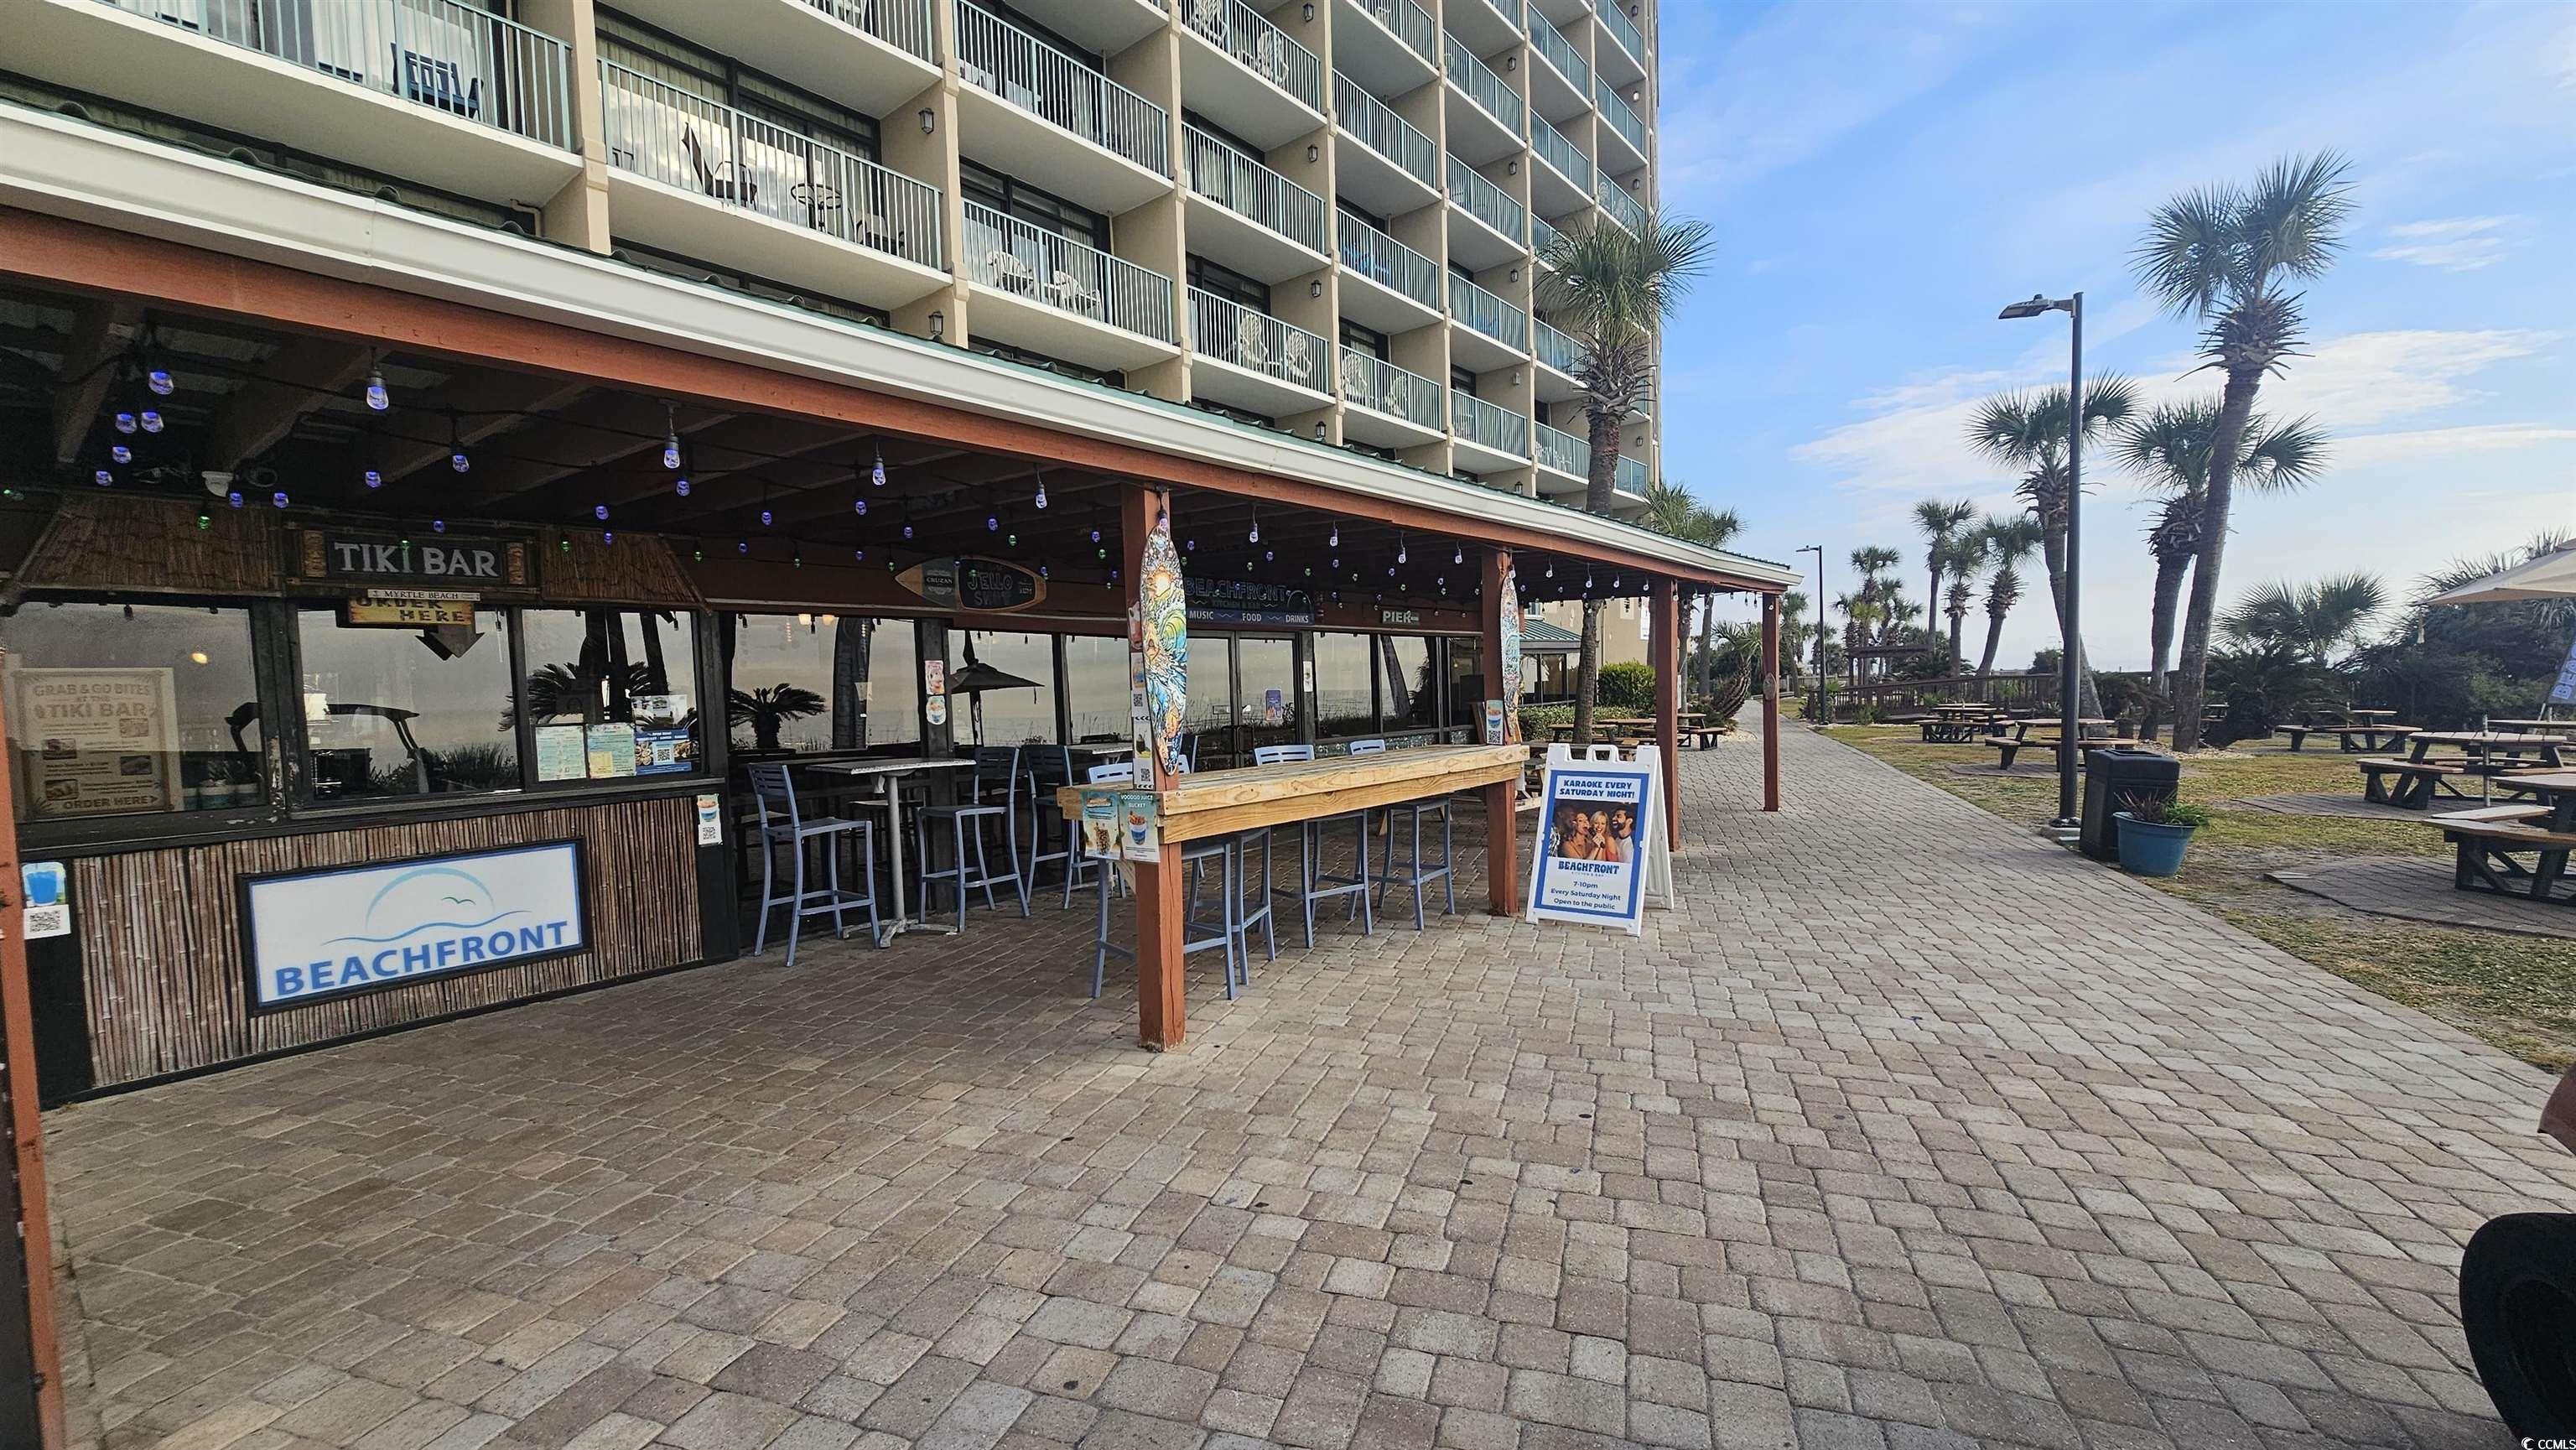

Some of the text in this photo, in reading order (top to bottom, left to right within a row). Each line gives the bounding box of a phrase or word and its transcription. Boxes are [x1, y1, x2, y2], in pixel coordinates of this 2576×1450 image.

[334, 542, 501, 578] TIKI BAR
[926, 576, 953, 585] CRUZAN
[968, 571, 1013, 590] JELLO
[384, 590, 426, 599] MYRTLE
[428, 591, 459, 600] BEACH
[1183, 577, 1288, 602] BEACHFRONT
[399, 609, 465, 622] HERE
[1188, 610, 1309, 623] MUSIC FOOD DRINKS
[1382, 610, 1411, 624] PIER
[34, 683, 77, 696] GRAB
[91, 683, 112, 694] GO
[47, 702, 148, 719] TIKI BAR
[1563, 779, 1602, 788] KARAOKE
[1559, 788, 1604, 798] SATURDAY
[63, 796, 148, 809] ORDER HERE
[1558, 860, 1620, 874] BEACHFRONT
[1573, 881, 1598, 889] 7-10pm
[1550, 888, 1569, 897] Every
[1571, 890, 1601, 900] Saturday
[275, 920, 568, 996] BEACHFRONT
